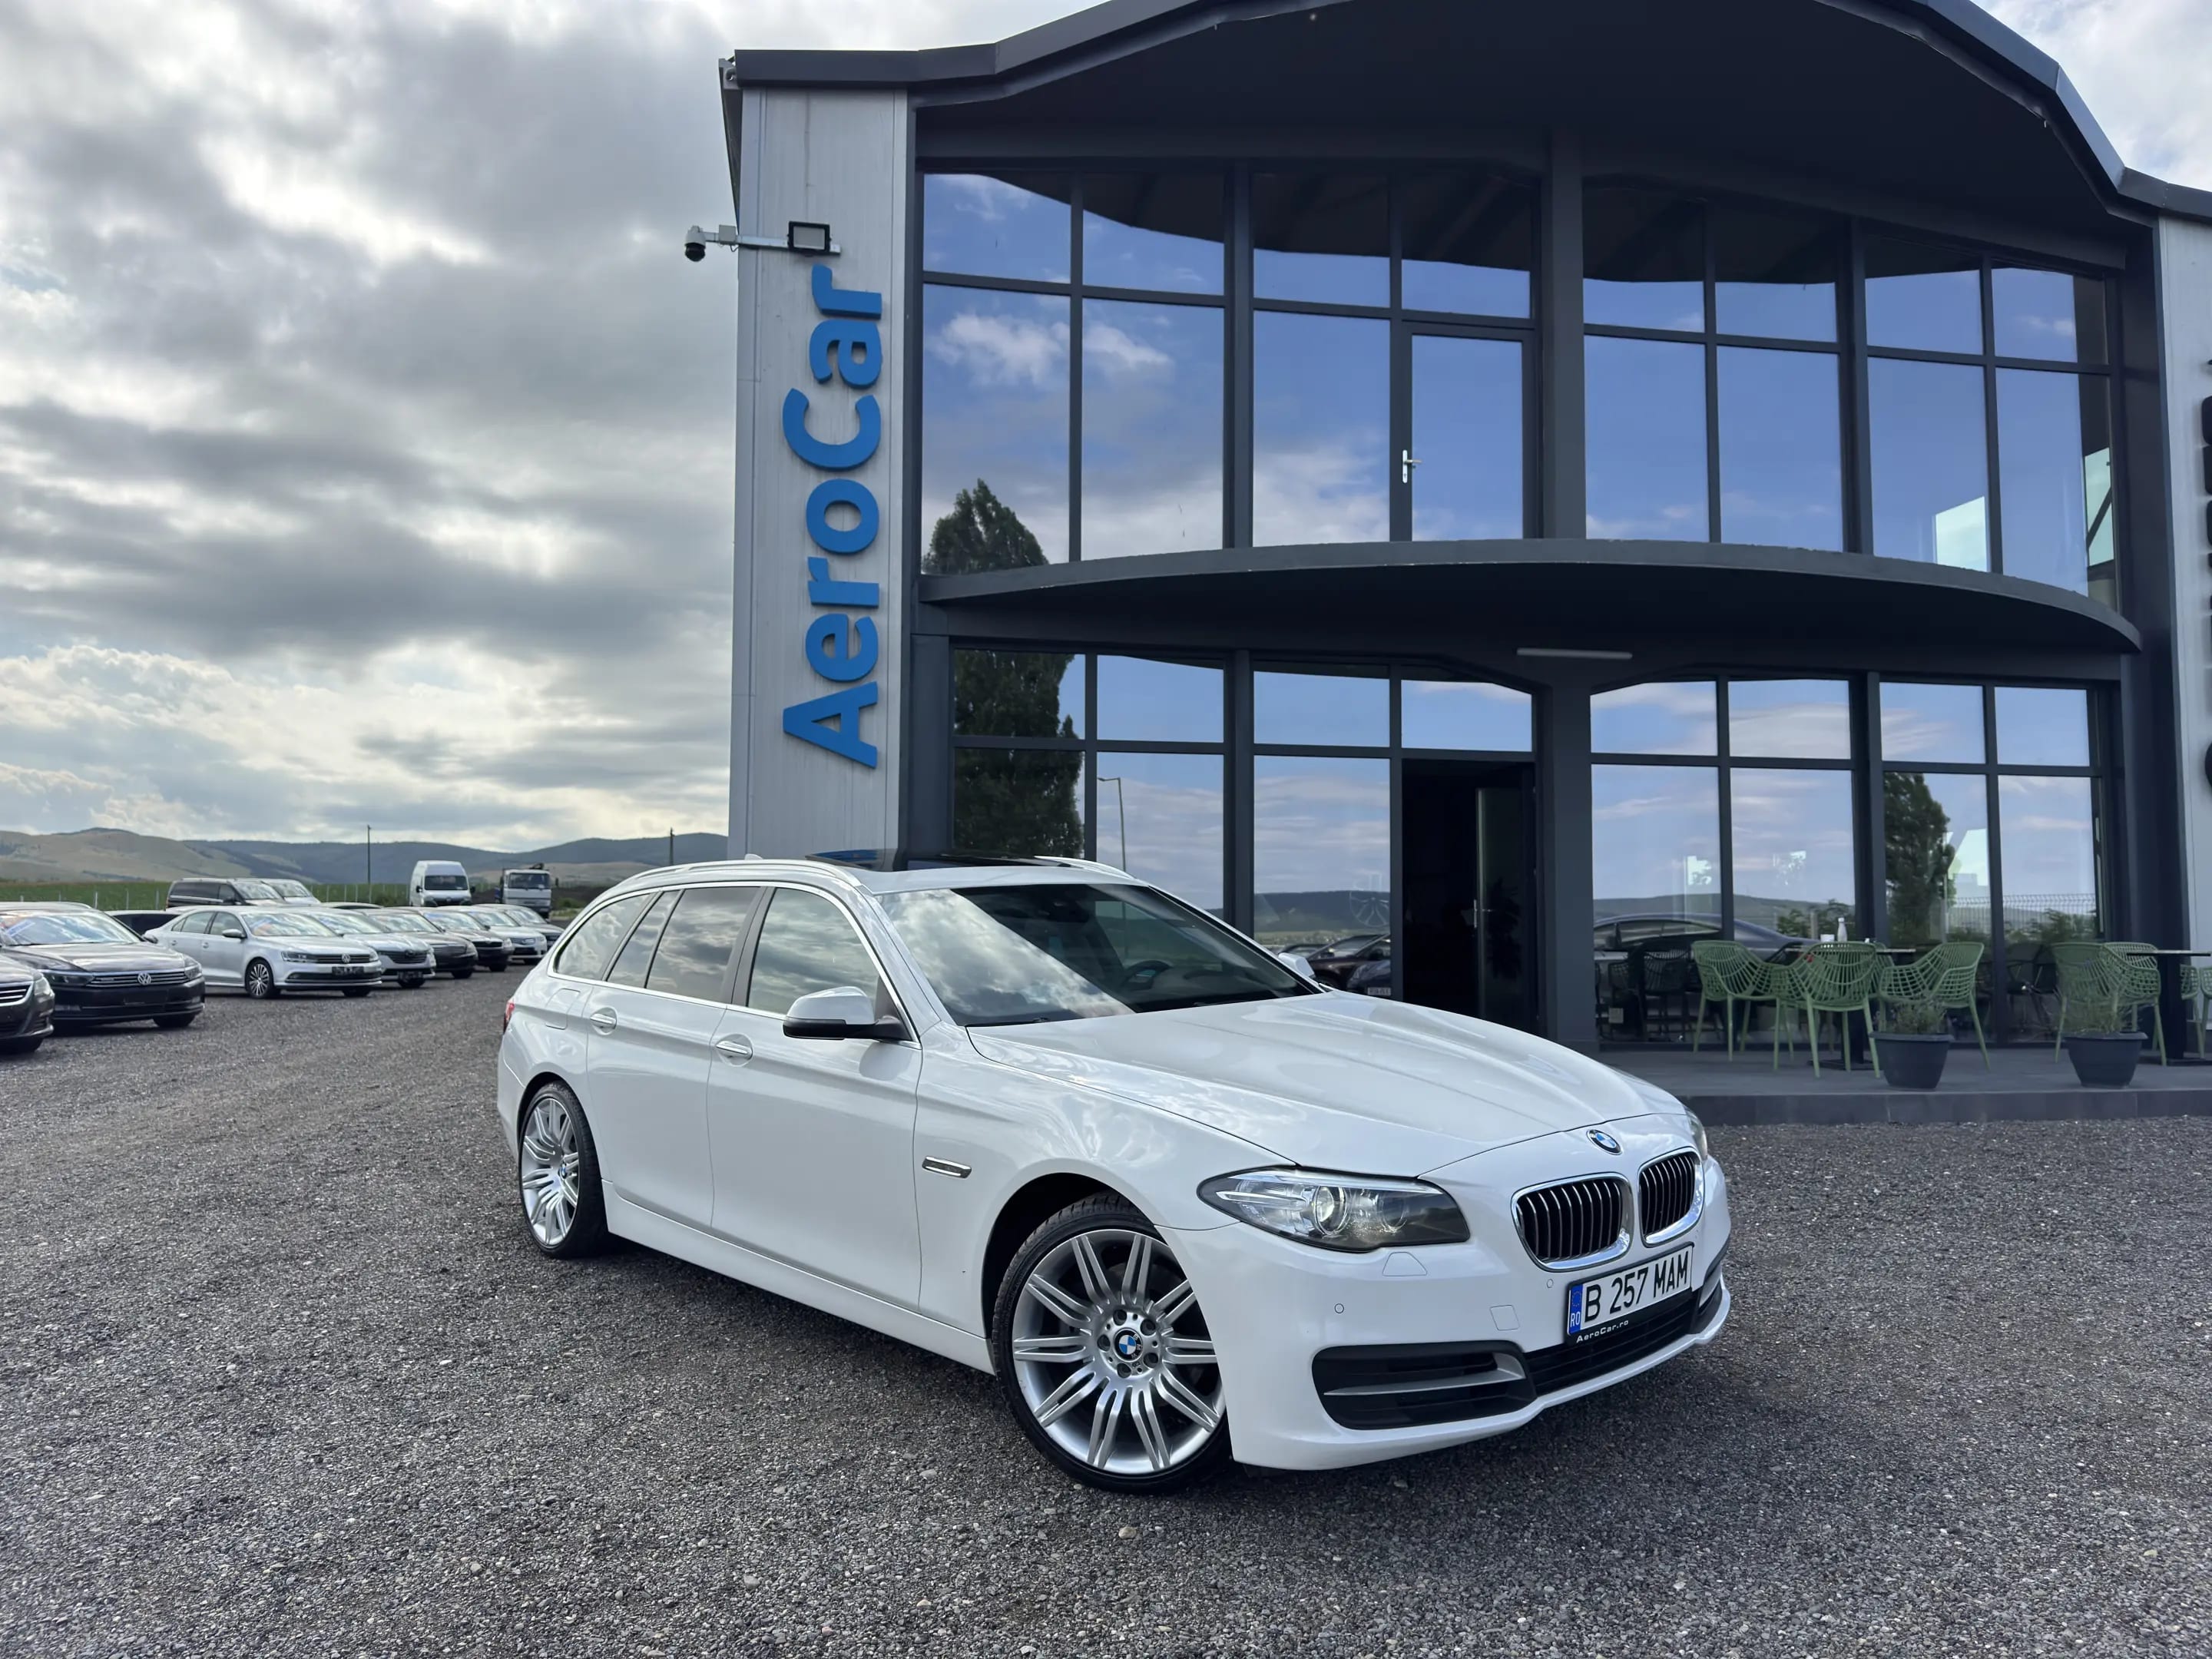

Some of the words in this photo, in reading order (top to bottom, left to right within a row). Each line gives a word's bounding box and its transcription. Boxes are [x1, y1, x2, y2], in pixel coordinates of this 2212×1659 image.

[783, 264, 882, 768] AeroCar
[138, 972, 151, 985] VW
[1584, 1284, 1601, 1323] B
[1609, 1267, 1649, 1314] 257
[1653, 1250, 1689, 1298] MAM
[1570, 1311, 1581, 1328] RO
[1576, 1320, 1629, 1343] AeroCar.ro
